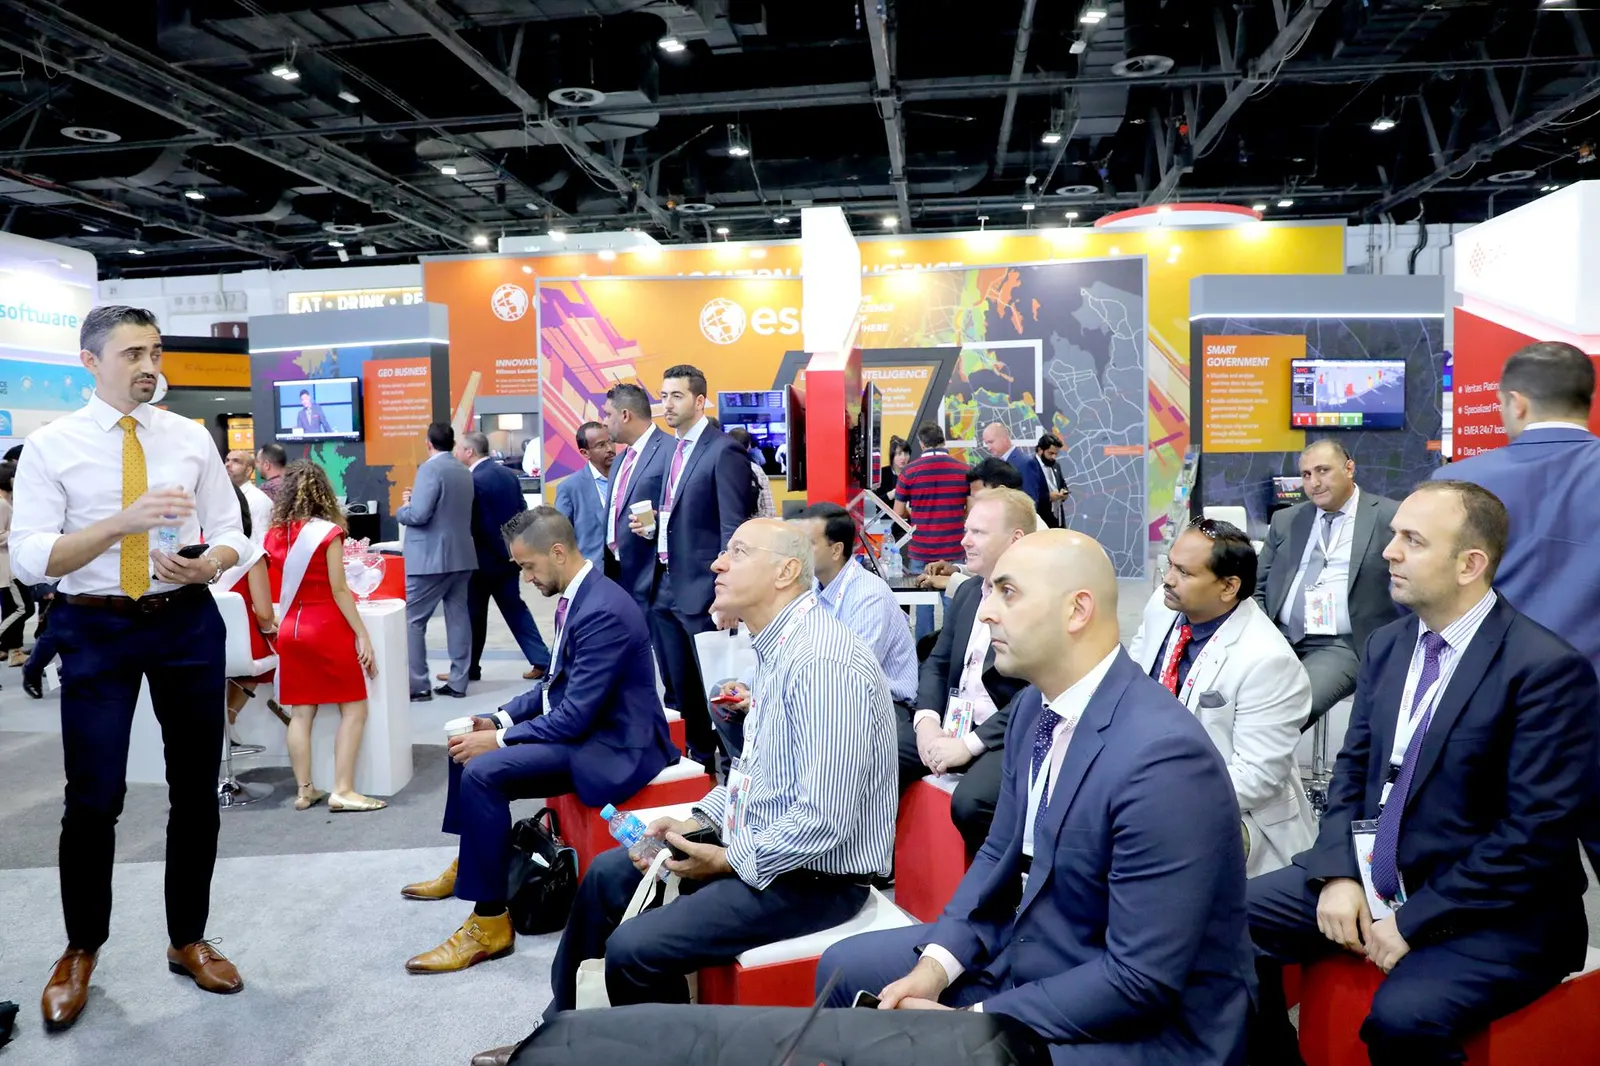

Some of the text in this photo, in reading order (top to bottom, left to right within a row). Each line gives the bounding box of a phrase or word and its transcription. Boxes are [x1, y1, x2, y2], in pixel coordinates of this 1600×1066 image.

[337, 294, 386, 311] DRINK
[402, 292, 423, 306] RE
[750, 307, 802, 335] es
[1207, 345, 1237, 355] SMART
[496, 359, 537, 367] INNOVATI
[1207, 357, 1270, 367] GOVERNMENT
[378, 366, 427, 378] GEO BUSINESS
[861, 369, 928, 380] NTELLIGENCE
[1464, 384, 1482, 393] Veritas
[1464, 404, 1491, 416] Specialized
[1464, 425, 1507, 435] EMEA 24x7 loca
[1463, 447, 1476, 456] Data
